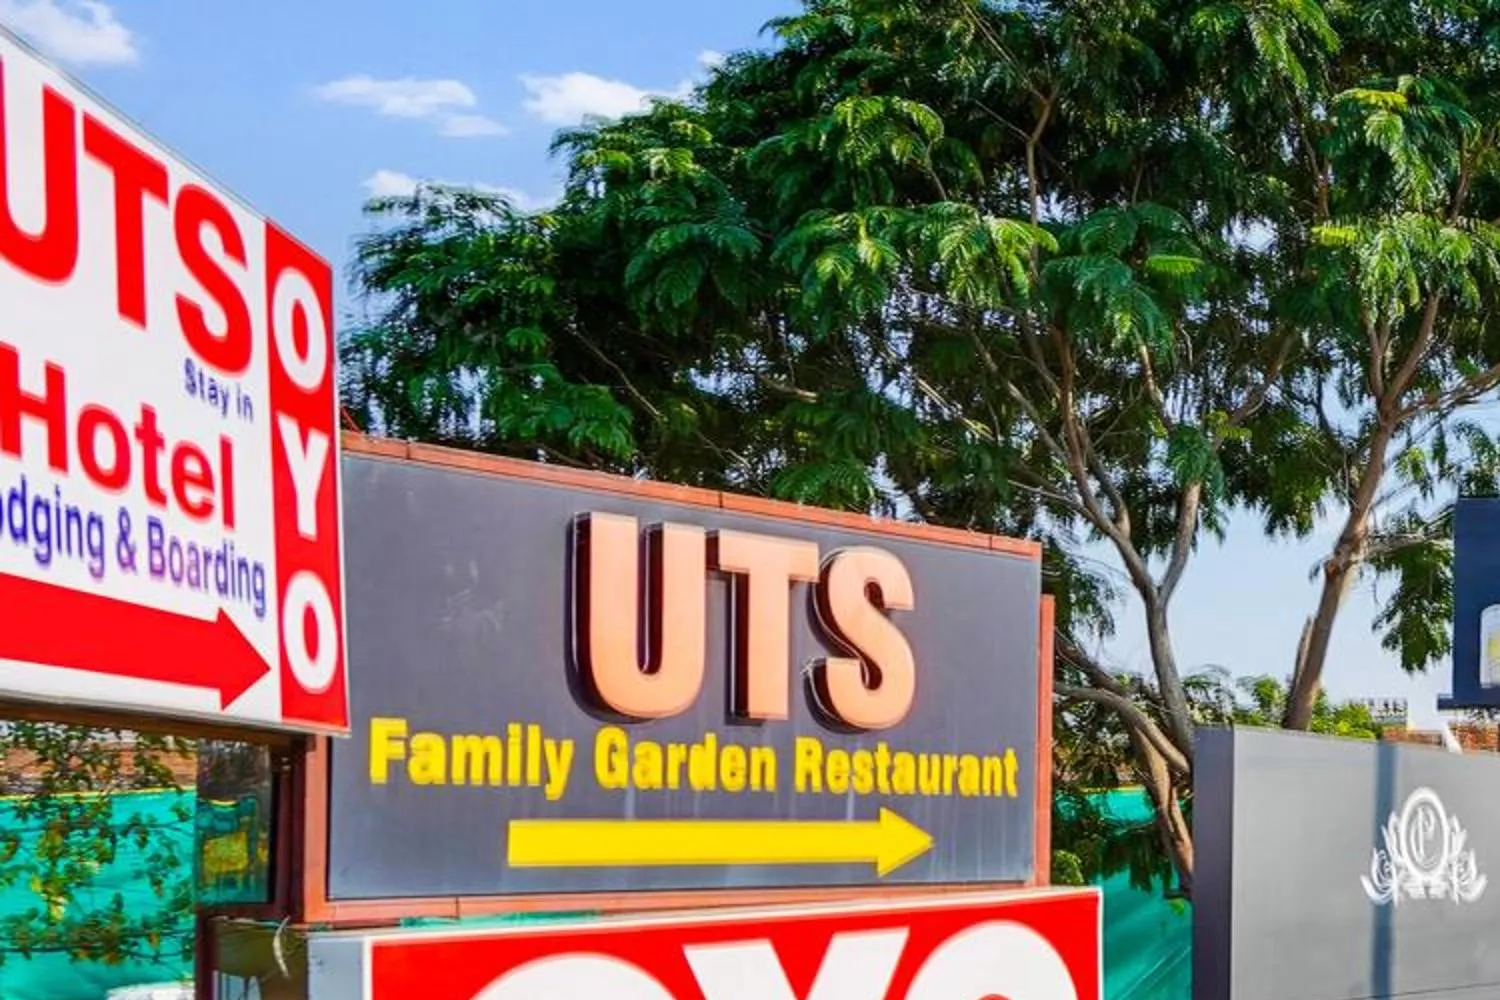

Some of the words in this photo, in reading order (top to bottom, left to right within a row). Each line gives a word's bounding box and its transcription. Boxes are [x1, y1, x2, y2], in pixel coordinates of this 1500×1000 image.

[0, 54, 253, 374] UTS
[0, 341, 236, 529] Hotel
[184, 358, 228, 417] Stay
[237, 382, 254, 421] in
[272, 267, 338, 692] OYO
[0, 473, 105, 580] dging
[116, 506, 138, 574] &
[147, 514, 266, 622] Boarding
[572, 511, 916, 731] UTS
[370, 717, 574, 800] Family
[595, 727, 775, 793] Garden
[795, 736, 1019, 798] Restaurant
